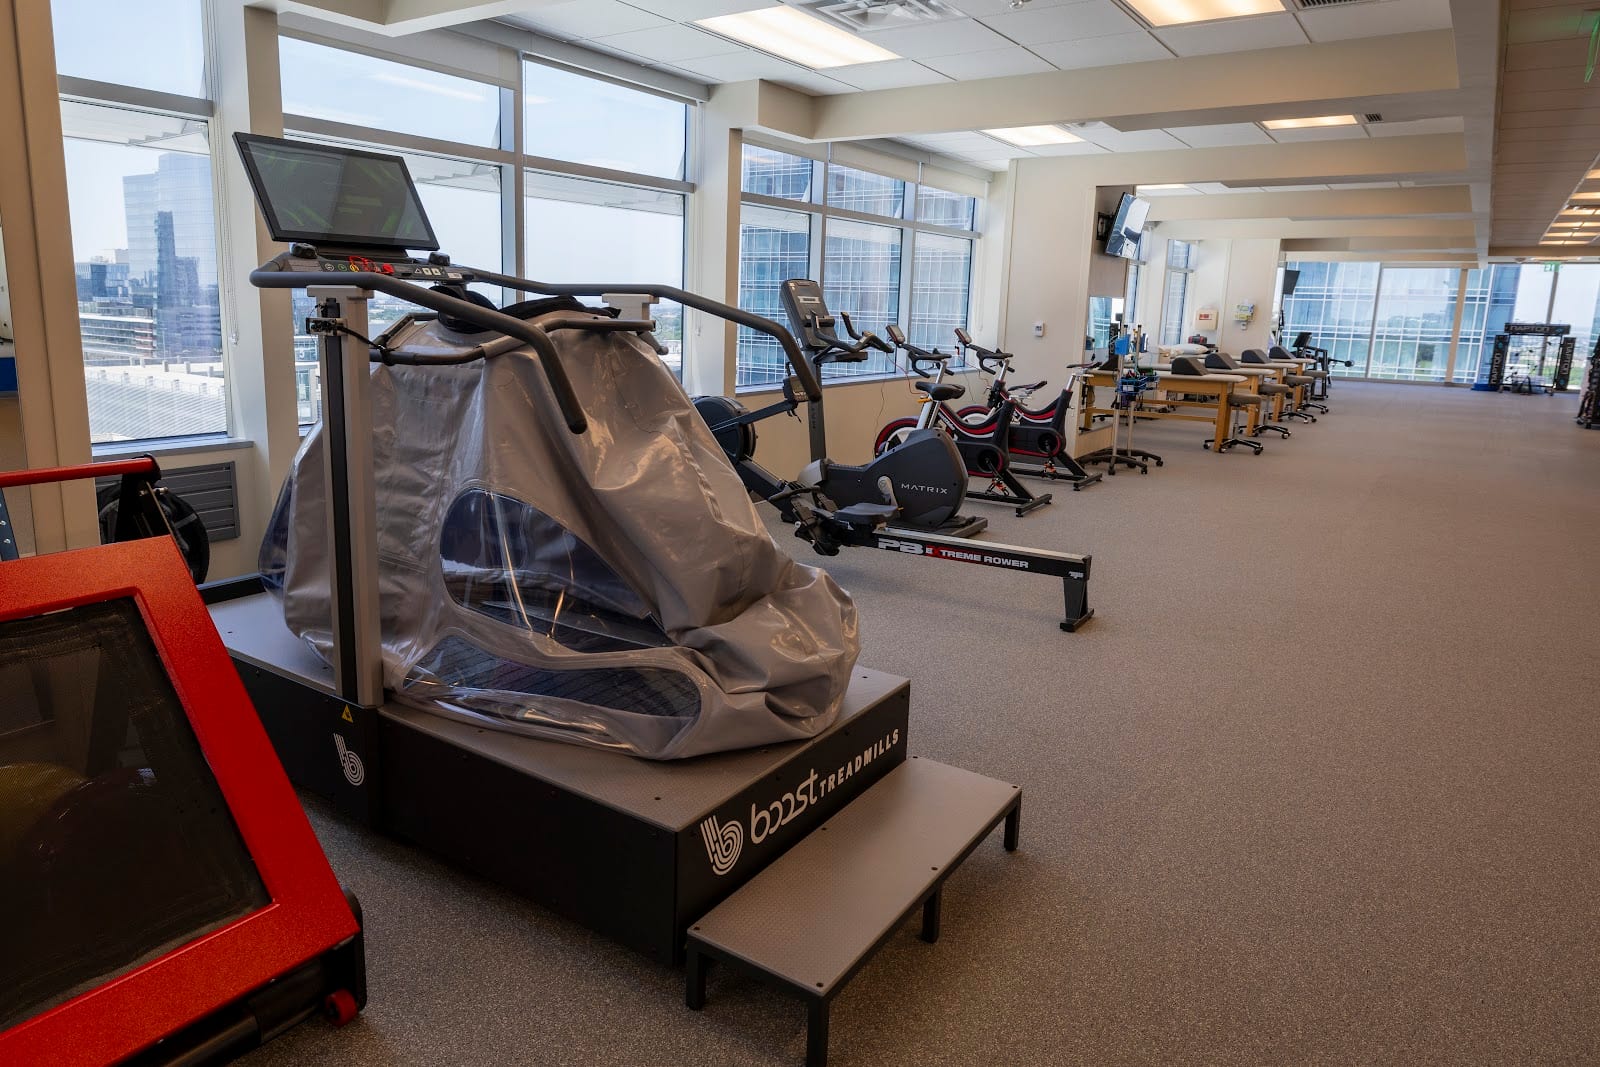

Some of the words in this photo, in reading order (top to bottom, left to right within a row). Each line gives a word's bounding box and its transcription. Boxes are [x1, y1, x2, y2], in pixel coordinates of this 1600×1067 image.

[901, 483, 948, 494] MATRIX
[983, 556, 1029, 569] ROWER
[819, 728, 899, 798] TREADMILLS
